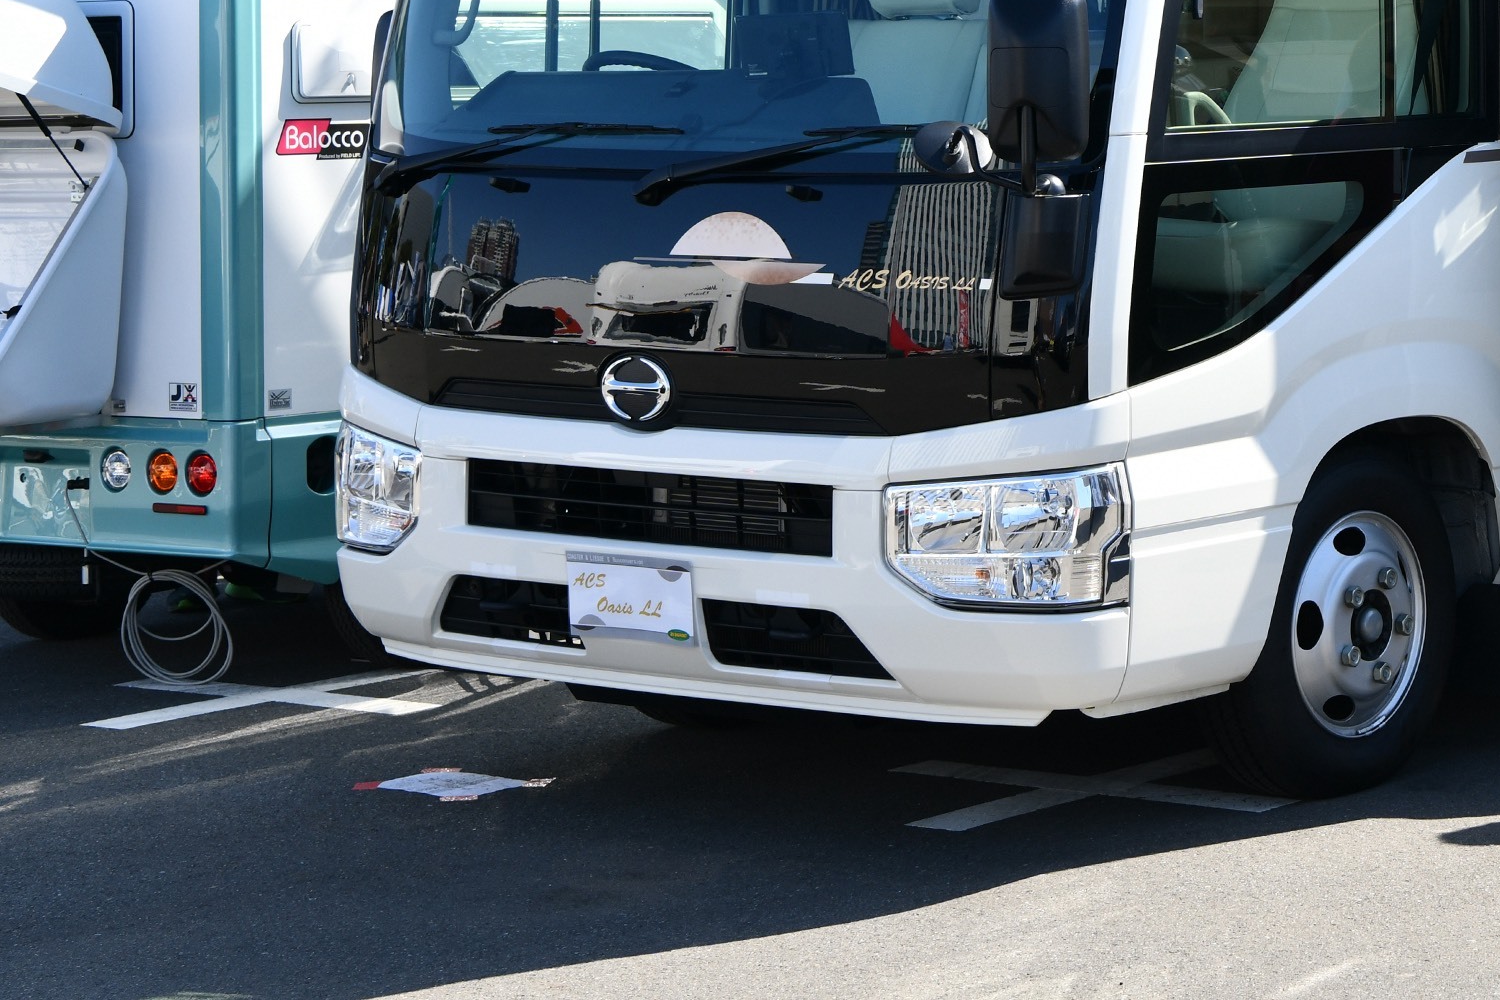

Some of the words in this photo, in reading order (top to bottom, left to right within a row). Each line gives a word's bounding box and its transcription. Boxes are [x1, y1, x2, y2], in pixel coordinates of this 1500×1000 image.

[285, 124, 364, 149] Balocco
[838, 268, 890, 292] ACS
[573, 572, 606, 589] ACS
[596, 596, 634, 615] Oasis
[639, 600, 663, 618] LL
